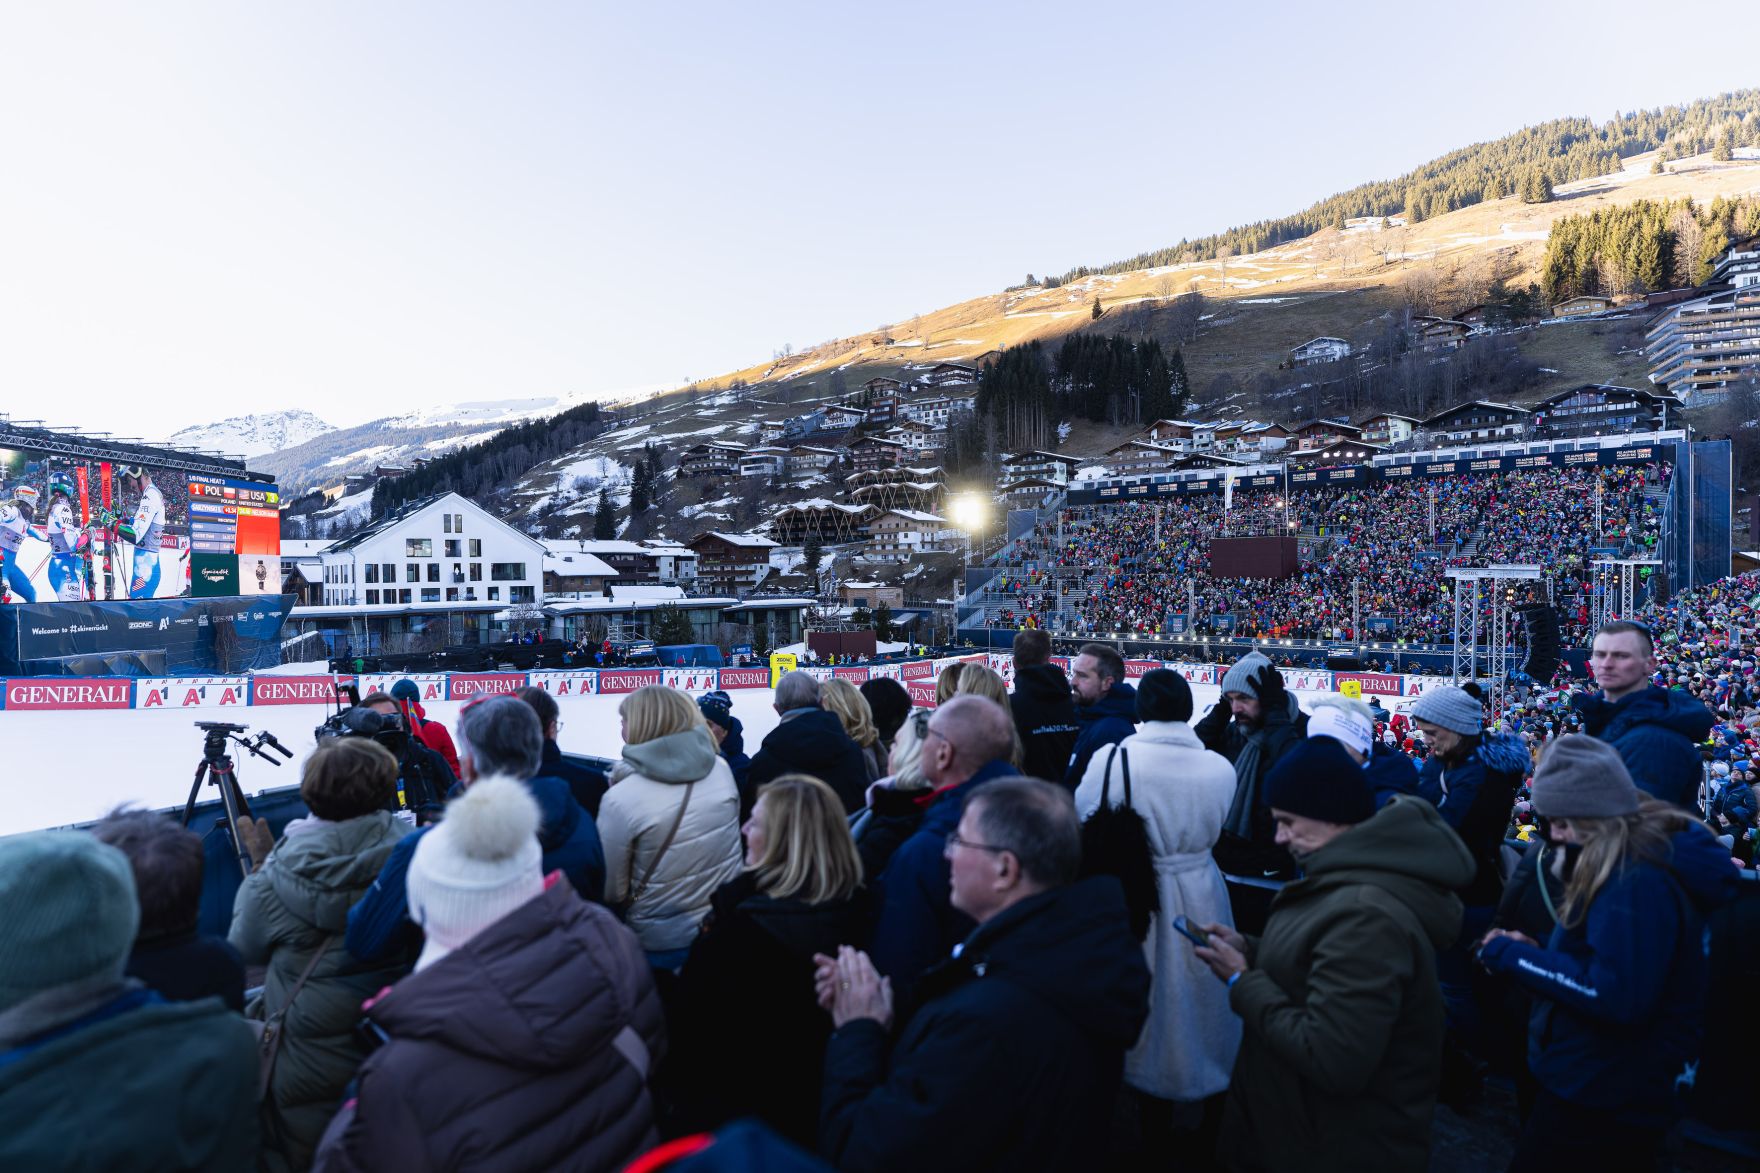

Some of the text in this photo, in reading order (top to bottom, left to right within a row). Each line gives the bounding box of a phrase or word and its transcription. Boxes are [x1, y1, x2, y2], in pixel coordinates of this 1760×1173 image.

[194, 484, 222, 496] 1 POL
[250, 492, 275, 502] USA 3
[159, 616, 170, 630] A1
[32, 627, 60, 635] Welcome
[903, 666, 931, 676] GENERALI
[1185, 670, 1212, 682] A1 A1
[602, 675, 659, 690] GENERALI
[668, 676, 714, 690] A1 A1 A1
[721, 672, 768, 685] GENERALI
[1296, 676, 1308, 688] A1
[1316, 678, 1328, 690] A1
[424, 682, 442, 700] A1
[452, 680, 524, 694] GENERALI
[558, 678, 572, 695] A1
[580, 678, 594, 694] A1
[1408, 682, 1423, 696] A1
[10, 685, 128, 704] GENERALI
[144, 686, 242, 707] A1 A1 A1
[908, 687, 936, 702] GENE
